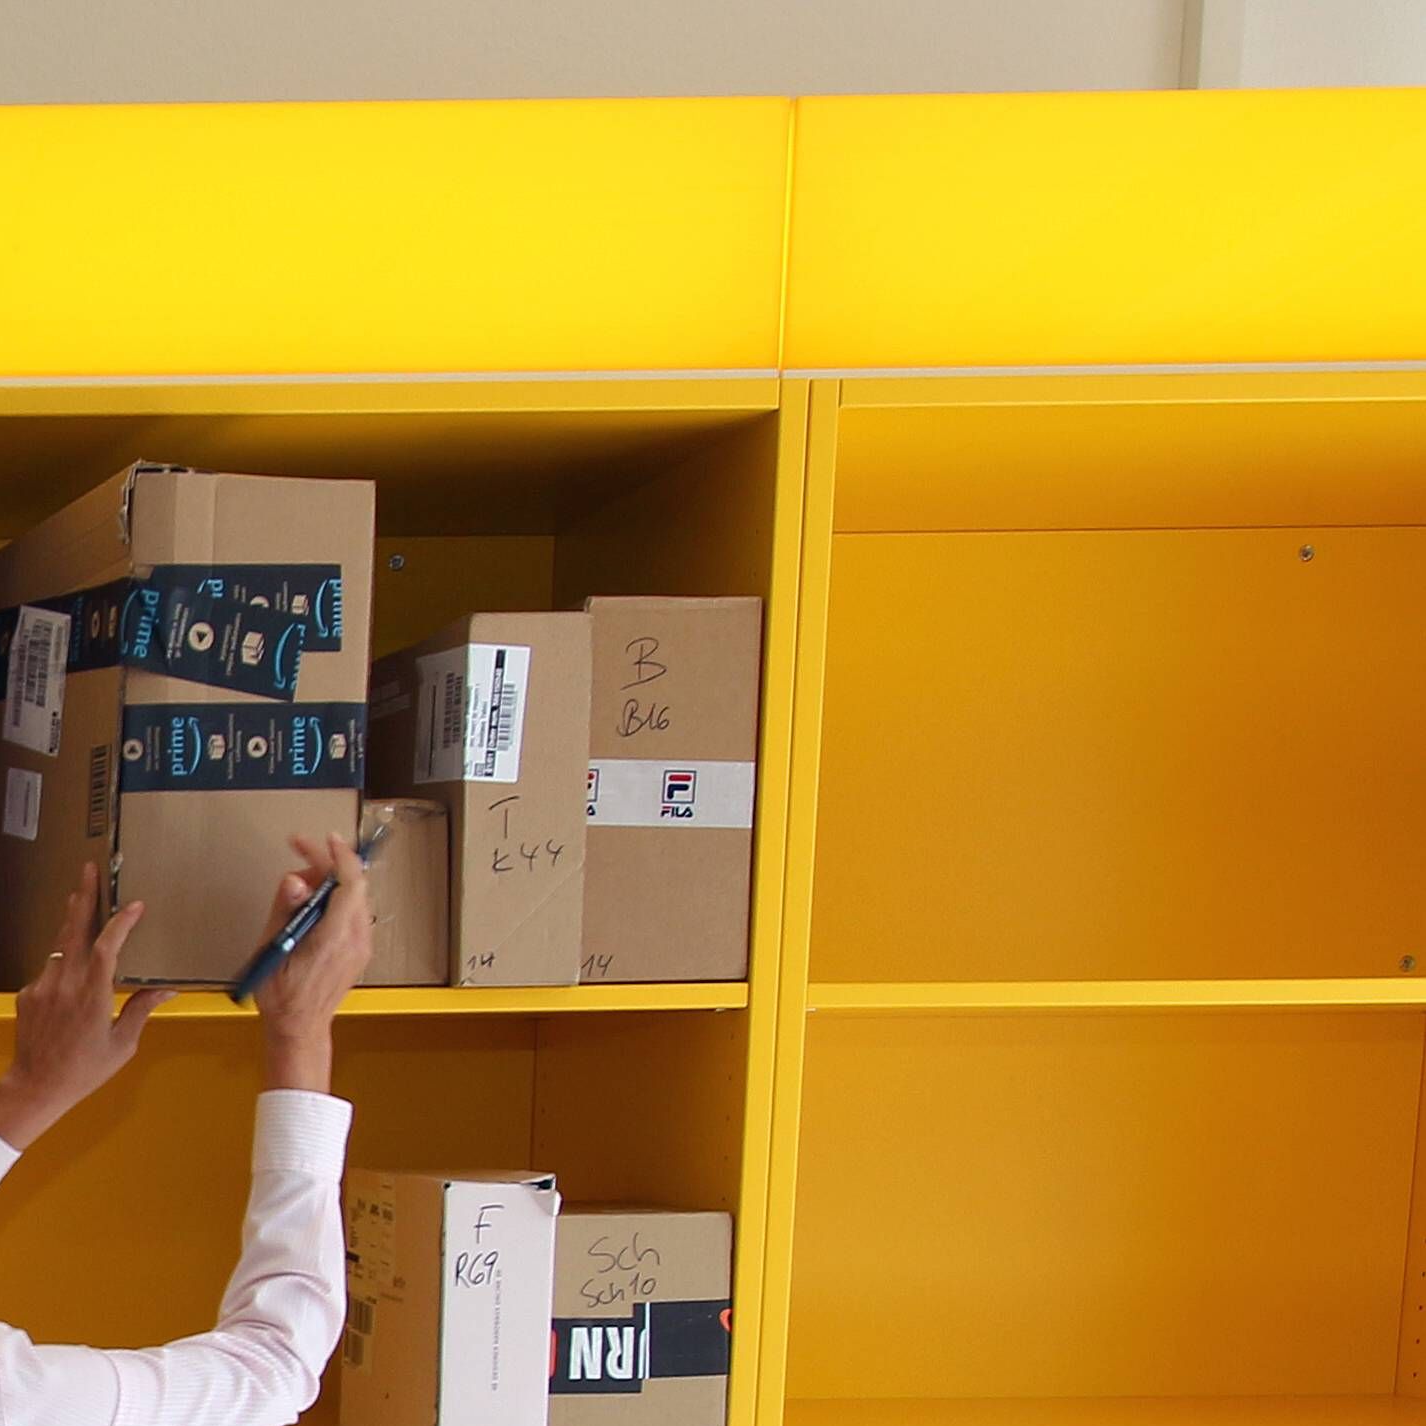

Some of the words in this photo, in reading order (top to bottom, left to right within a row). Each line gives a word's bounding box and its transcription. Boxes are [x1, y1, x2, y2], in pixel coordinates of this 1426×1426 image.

[132, 589, 160, 659] prime
[619, 636, 668, 691] B
[616, 698, 670, 738] B16
[169, 716, 187, 776] prime
[290, 716, 309, 776] prime
[660, 805, 694, 819] FILA
[467, 951, 496, 970] 14
[581, 954, 614, 977] 14
[473, 1203, 505, 1244] F
[454, 1251, 498, 1288] R69
[587, 1232, 662, 1274] Sch
